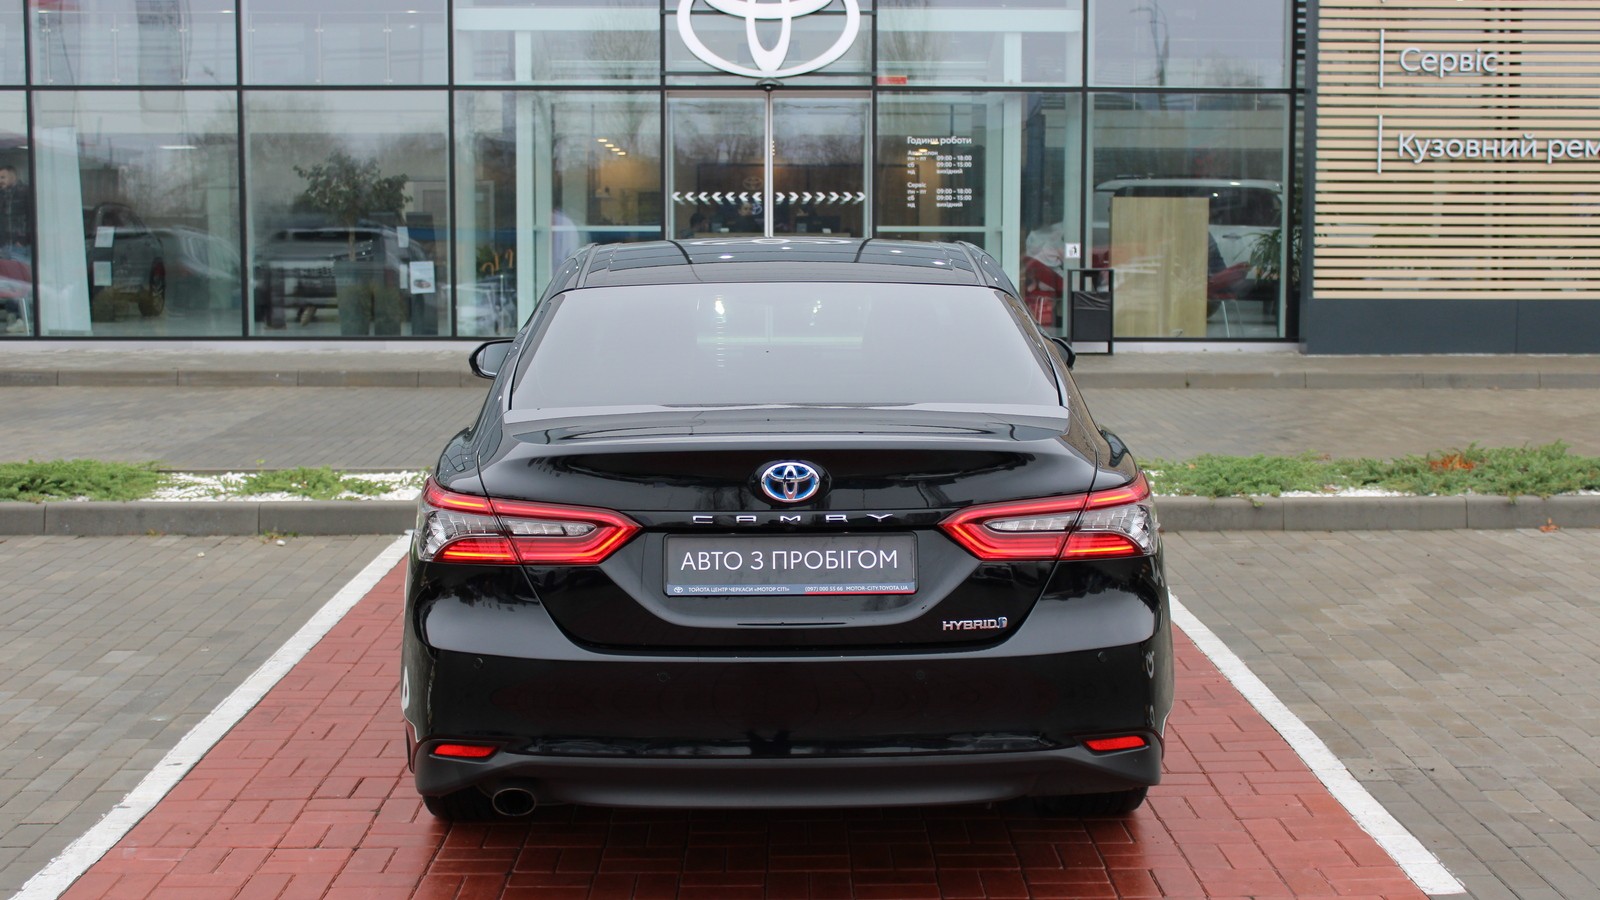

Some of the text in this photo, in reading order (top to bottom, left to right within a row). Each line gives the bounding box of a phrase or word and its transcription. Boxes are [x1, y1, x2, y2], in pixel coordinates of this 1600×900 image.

[1400, 47, 1498, 78] Сервіс
[907, 136, 972, 146] Години роботи
[1398, 133, 1537, 164] Кузовний
[692, 513, 893, 524] CAMRY
[680, 551, 743, 571] АВТО
[772, 550, 898, 570] ПРОБІГОМ
[942, 619, 998, 631] HYBRID
